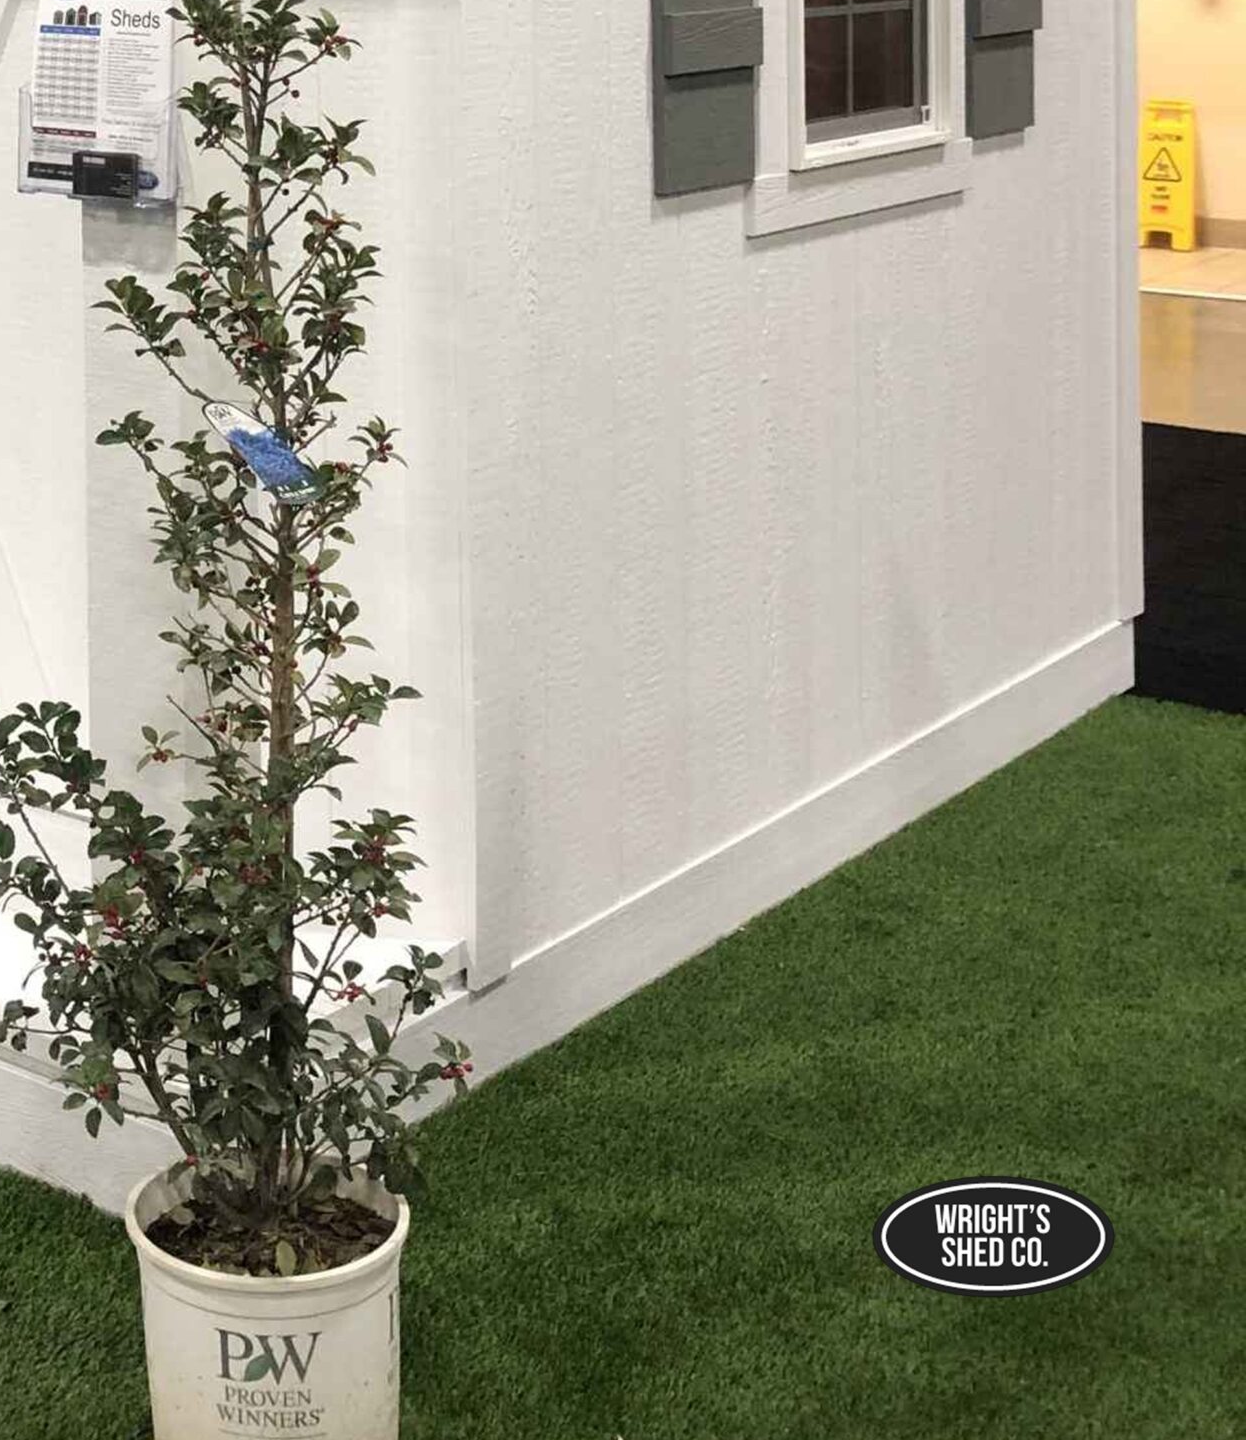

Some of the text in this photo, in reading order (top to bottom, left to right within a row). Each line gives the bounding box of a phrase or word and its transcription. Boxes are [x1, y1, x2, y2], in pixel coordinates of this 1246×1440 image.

[110, 8, 161, 29] Sheds
[225, 1385, 312, 1407] PROVEN
[216, 1403, 321, 1429] WINNERS
